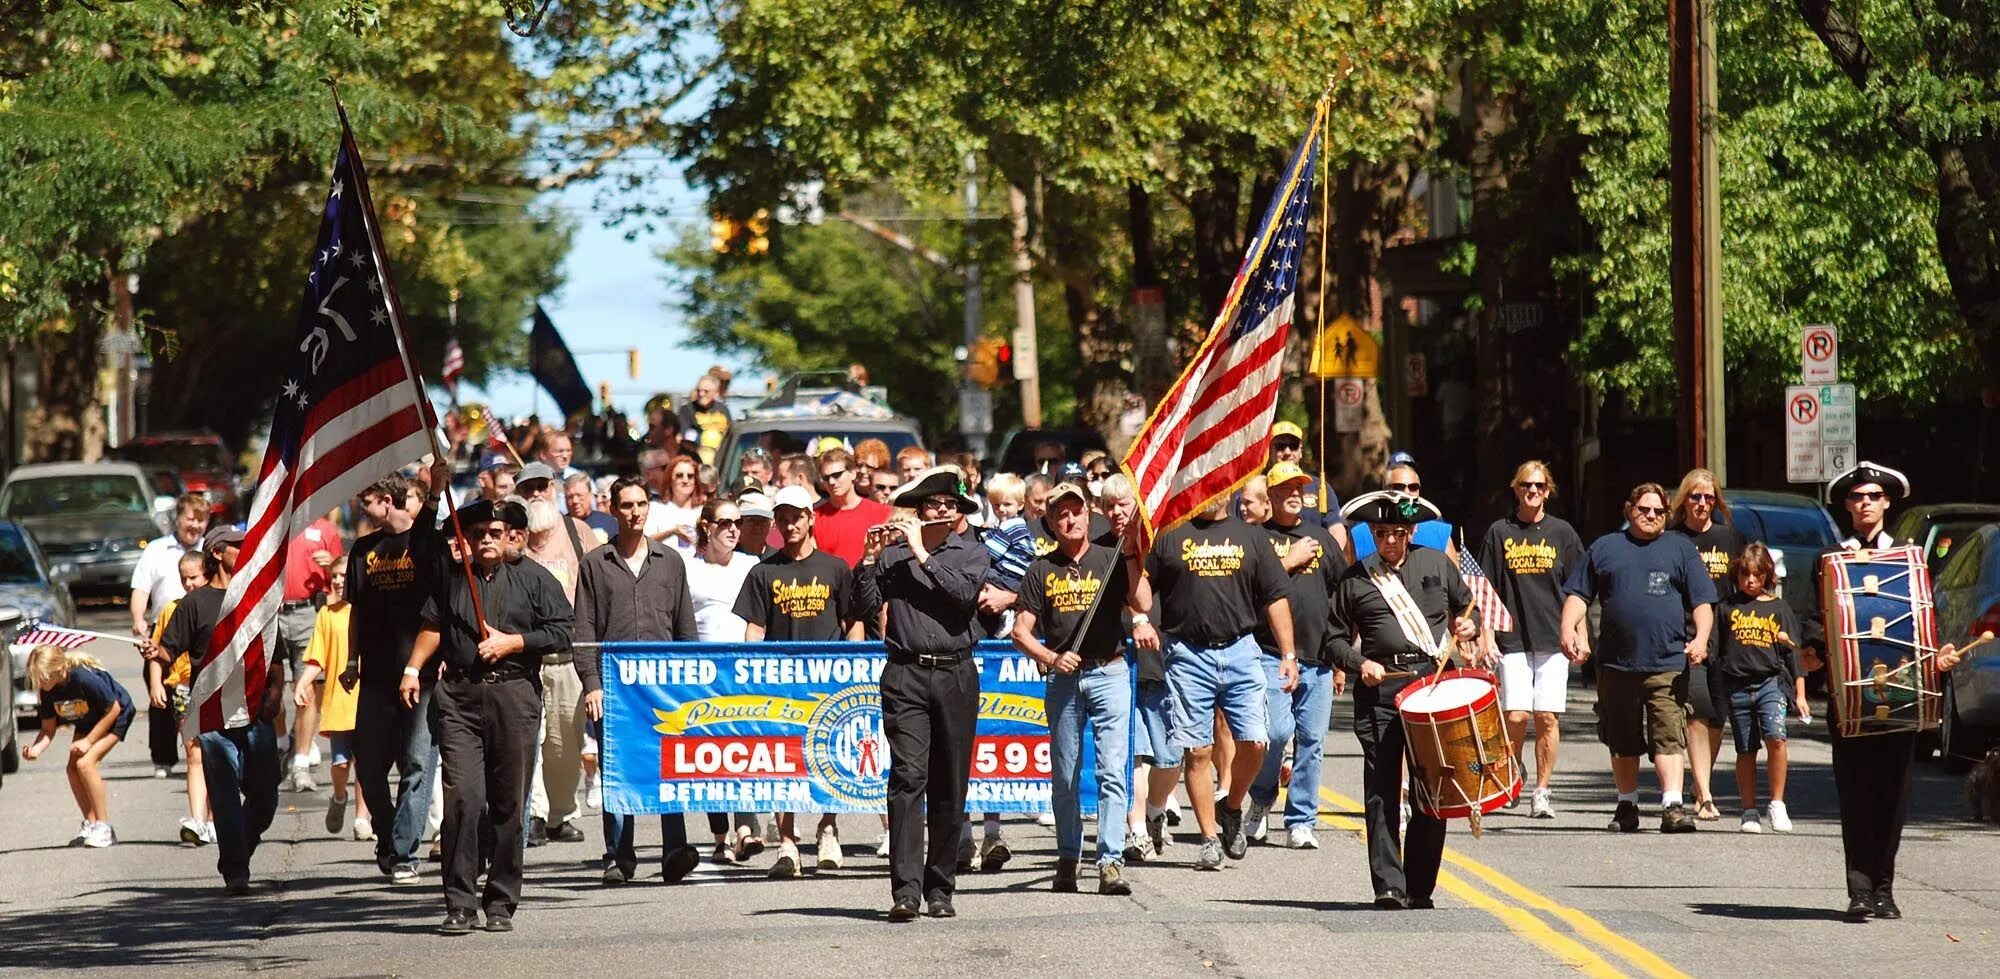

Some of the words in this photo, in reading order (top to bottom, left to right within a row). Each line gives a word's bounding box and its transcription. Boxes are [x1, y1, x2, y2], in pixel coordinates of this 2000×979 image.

[1833, 456, 1844, 469] G
[1182, 537, 1244, 561] Steelworkers
[1504, 537, 1556, 560] Steelworkers
[1189, 558, 1220, 571] LOCAL
[1221, 558, 1241, 570] 2599
[1508, 557, 1535, 568] LOCAL
[1536, 558, 1553, 568] 2599
[773, 576, 830, 604] Steelworkers
[1046, 570, 1101, 597] Steelworker
[807, 599, 825, 611] 2599
[619, 659, 717, 685] UNITED
[735, 658, 887, 684] STEELWORK
[686, 700, 772, 726] Proud
[782, 703, 803, 720] to
[674, 742, 796, 773] LOCAL
[975, 742, 1052, 774] 599
[659, 782, 811, 803] BETHLEHEM
